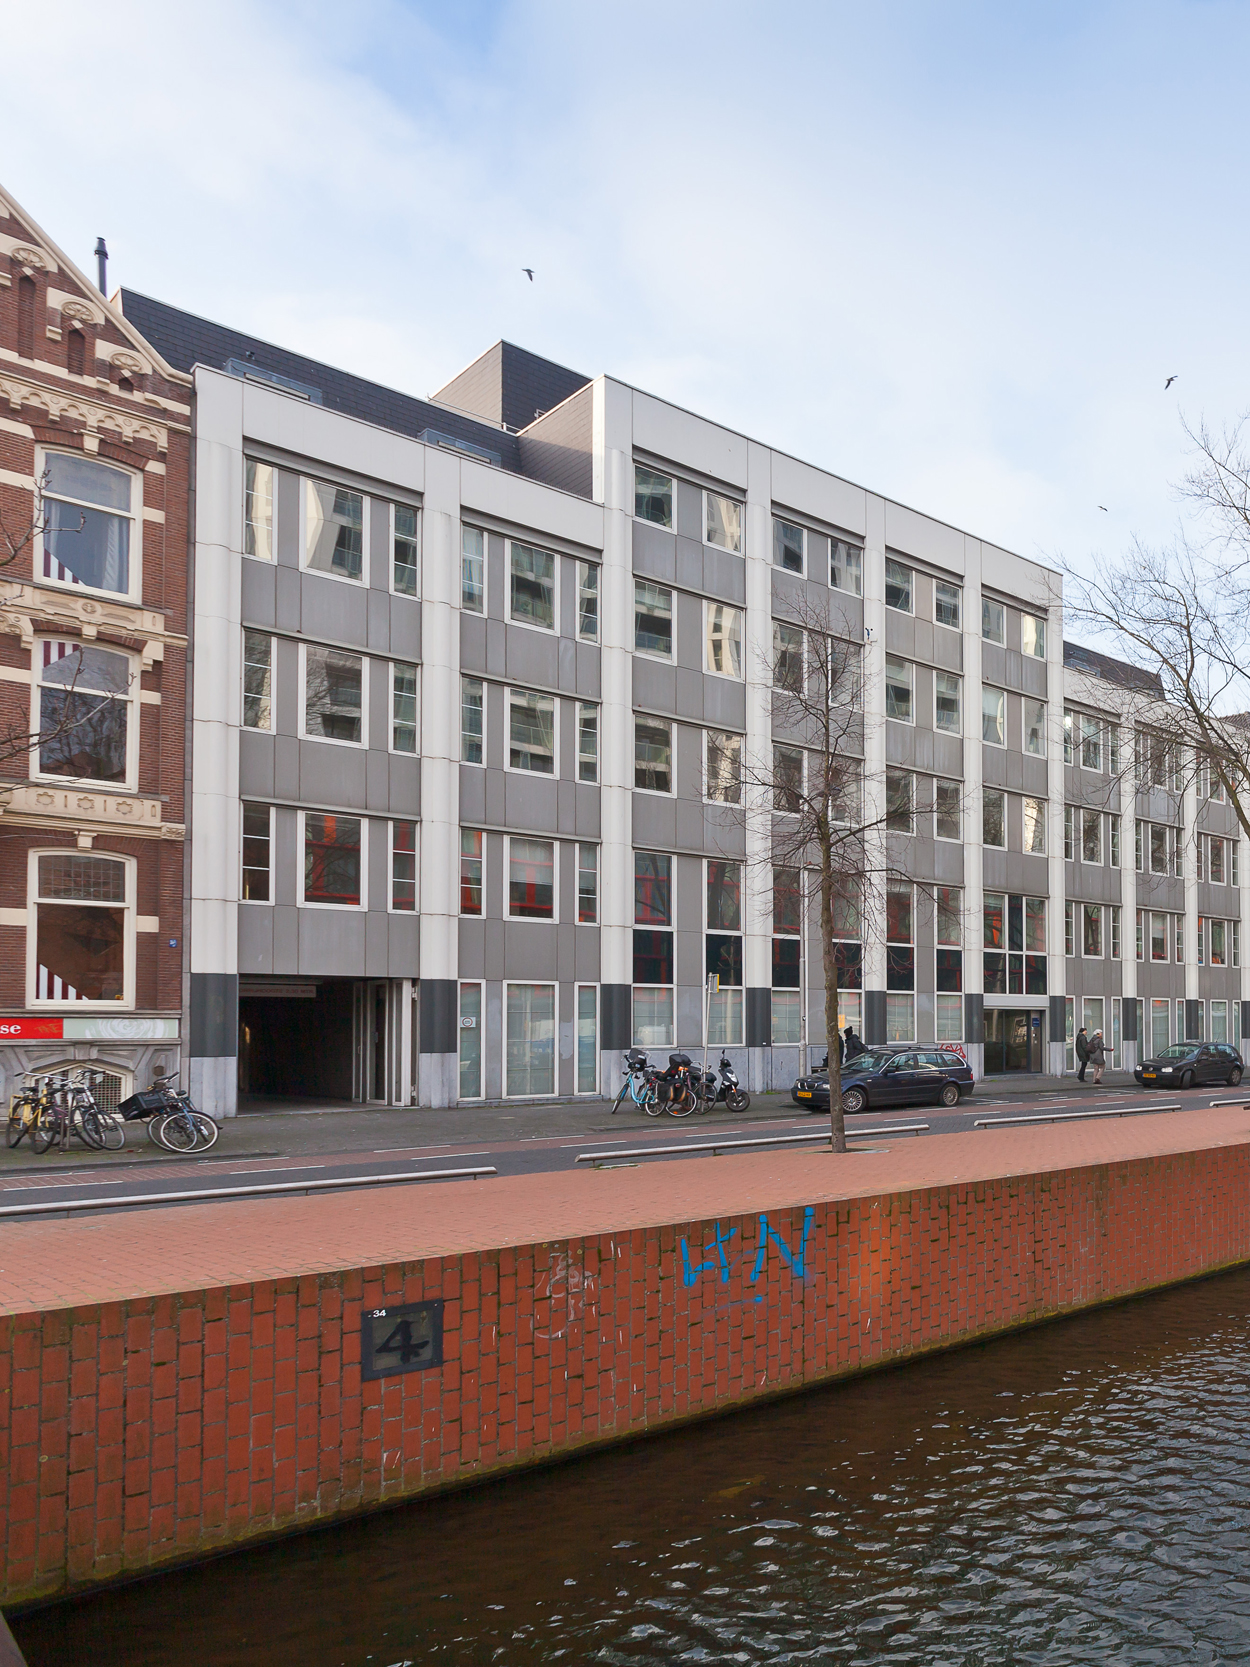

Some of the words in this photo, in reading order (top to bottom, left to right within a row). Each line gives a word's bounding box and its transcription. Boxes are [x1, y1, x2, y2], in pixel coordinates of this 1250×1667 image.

[0, 1024, 21, 1034] se
[373, 1309, 386, 1317] 34
[375, 1320, 430, 1364] 4
